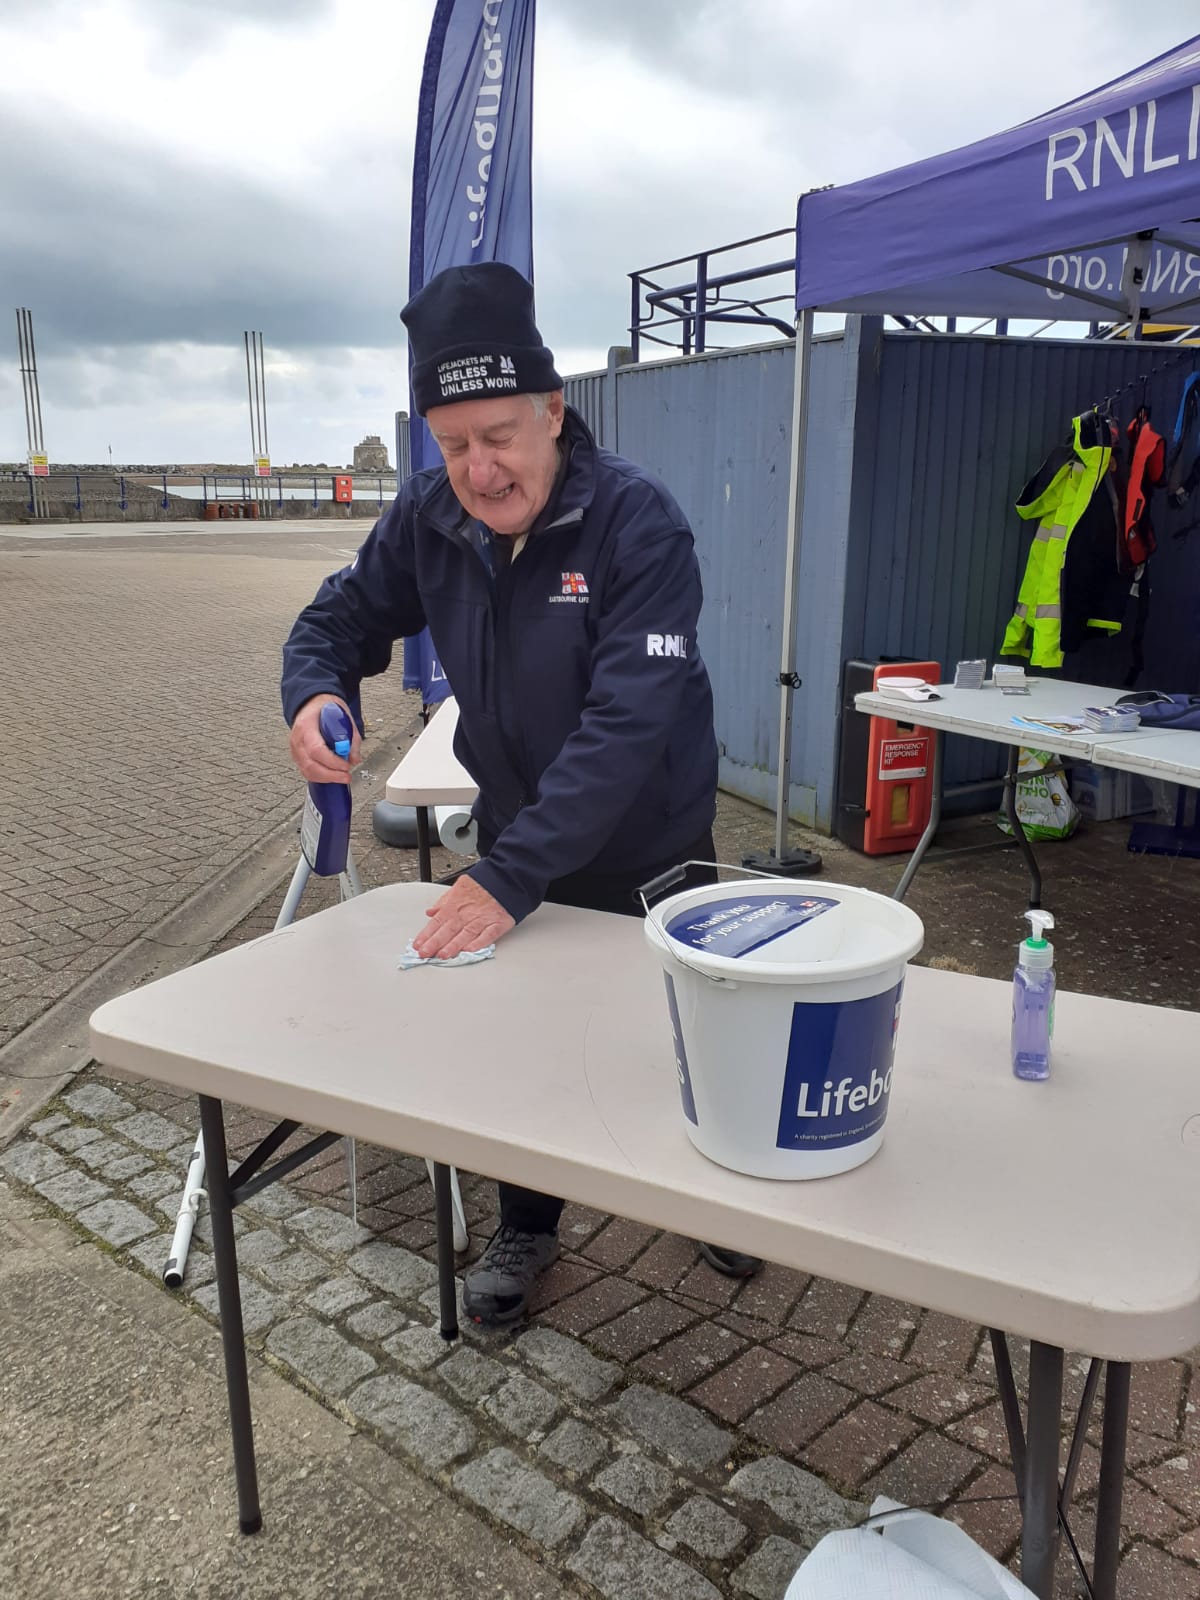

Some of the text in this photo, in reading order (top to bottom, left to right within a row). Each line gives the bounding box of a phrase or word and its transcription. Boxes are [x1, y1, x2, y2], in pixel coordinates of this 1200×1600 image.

[1046, 84, 1200, 200] RNLI
[437, 355, 494, 373] LIFEJACKETS ARE
[439, 366, 488, 385] USELESS
[441, 377, 517, 396] UNLESS WORN
[884, 750, 919, 759] RESPONSE
[885, 743, 924, 752] EMERGENCY
[884, 758, 893, 766] KIT
[687, 904, 751, 932] Thank you
[692, 901, 787, 945] for your support
